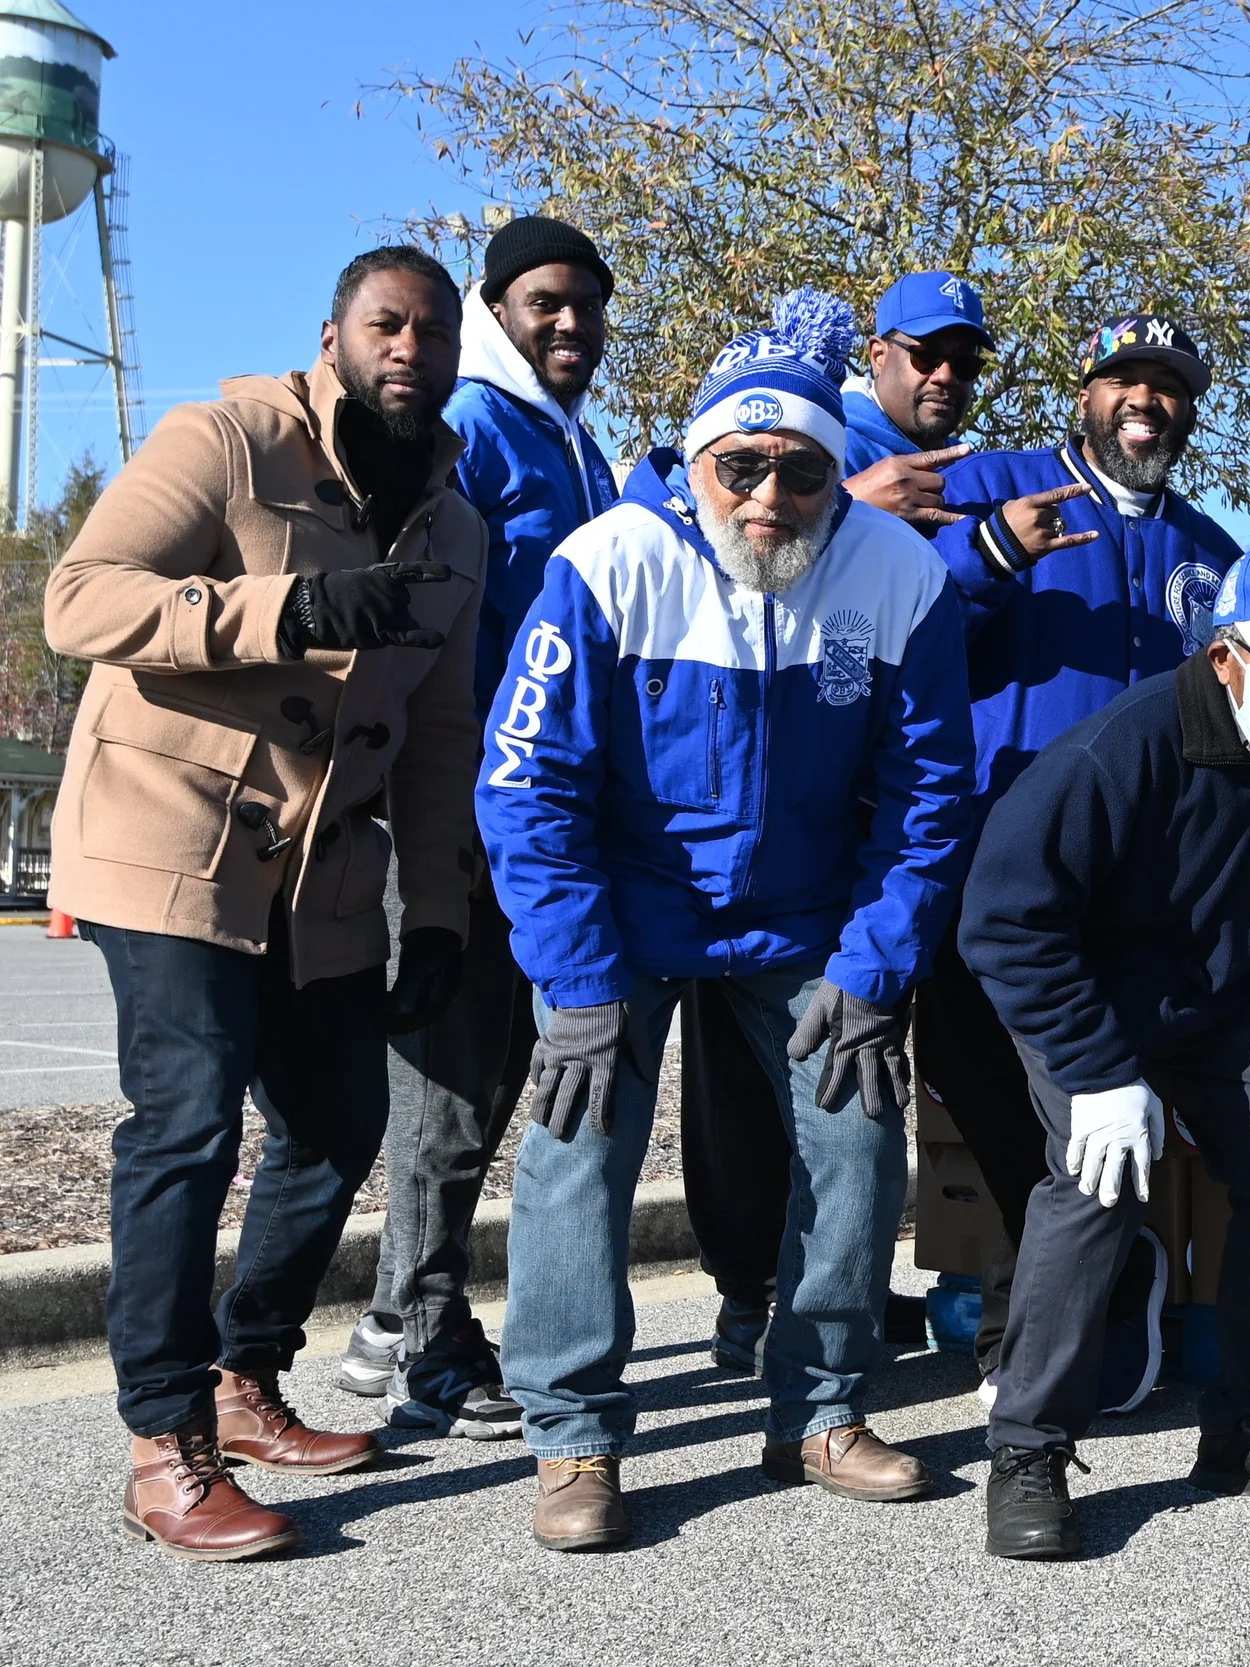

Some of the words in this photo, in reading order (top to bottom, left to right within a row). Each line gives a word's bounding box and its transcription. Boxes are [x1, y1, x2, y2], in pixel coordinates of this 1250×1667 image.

[938, 277, 965, 309] 4
[1144, 317, 1175, 347] NY
[424, 1369, 473, 1400] N
